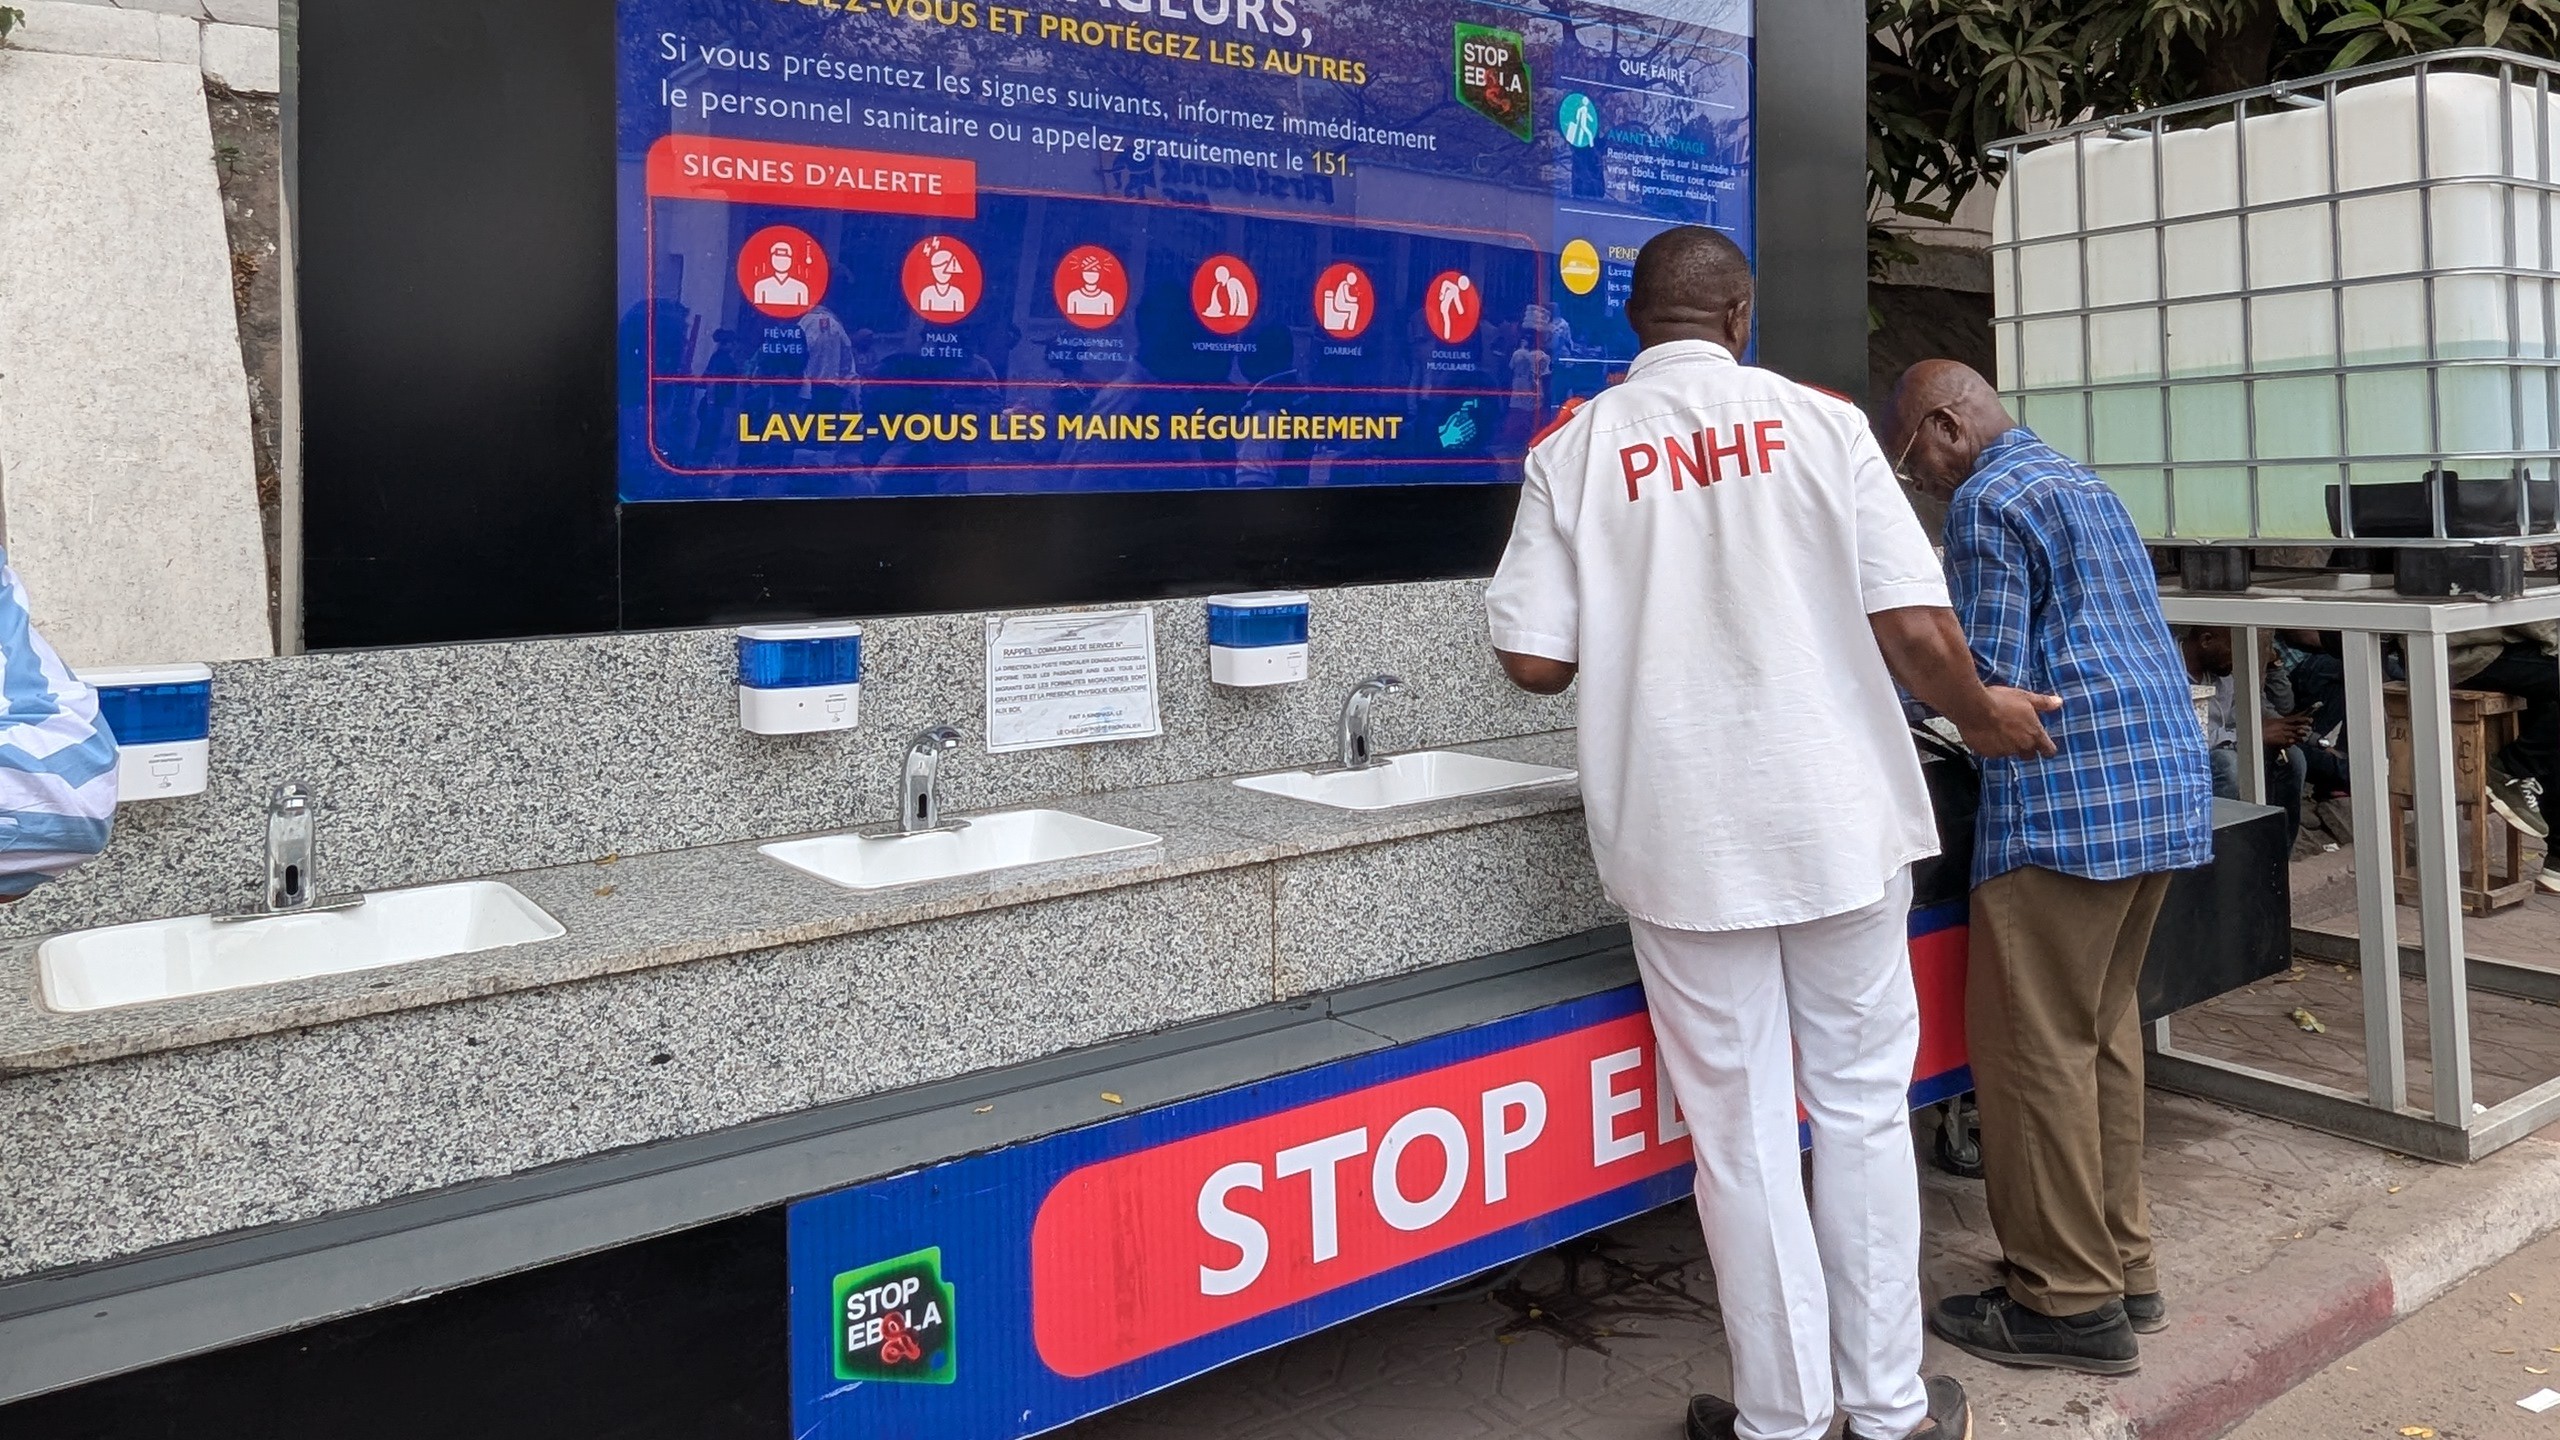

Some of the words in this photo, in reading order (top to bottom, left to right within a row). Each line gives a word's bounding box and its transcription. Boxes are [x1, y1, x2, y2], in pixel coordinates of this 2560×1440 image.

[990, 8, 1030, 35] ET
[1040, 15, 1200, 61] PROTÉGEZ
[1210, 39, 1255, 69] LES
[1264, 49, 1367, 85] AUTRES
[1464, 43, 1509, 67] STOP
[1619, 59, 1647, 76] QUE
[1651, 64, 1686, 84] FAIRE
[660, 32, 687, 62] Si
[700, 44, 771, 71] vous
[784, 53, 926, 89] présentez
[936, 65, 971, 95] les
[981, 75, 1057, 107] signes
[1067, 87, 1169, 121] suivants,
[1178, 98, 1275, 131] informez
[1283, 112, 1437, 151] immédiatement
[661, 78, 688, 108] le
[701, 90, 851, 124] personnel
[863, 107, 979, 137] sanitaire
[989, 121, 1022, 142] ou
[1031, 126, 1125, 154] appelez
[1132, 137, 1279, 170] gratuitement
[1286, 148, 1304, 171] le
[1311, 151, 1354, 177] 151.
[1607, 129, 1646, 146] AVANT
[1661, 135, 1705, 155] VOYAGE
[684, 153, 795, 184] SIGNES
[805, 163, 943, 196] D'ALERTE
[1608, 246, 1640, 261] PEND
[763, 326, 801, 339] FIÈVRE
[926, 332, 958, 343] MAUX
[920, 347, 935, 357] DE
[739, 413, 978, 442] LAVEZ-VOUS
[990, 413, 1046, 441] LES
[1057, 414, 1160, 440] MAINS
[1170, 408, 1403, 440] RÉGULIÈREMENT
[1619, 419, 1785, 503] PNHF
[1003, 647, 1032, 656] RAPPEL
[1197, 1080, 1549, 1297] STOP
[847, 1277, 919, 1320] STOP
